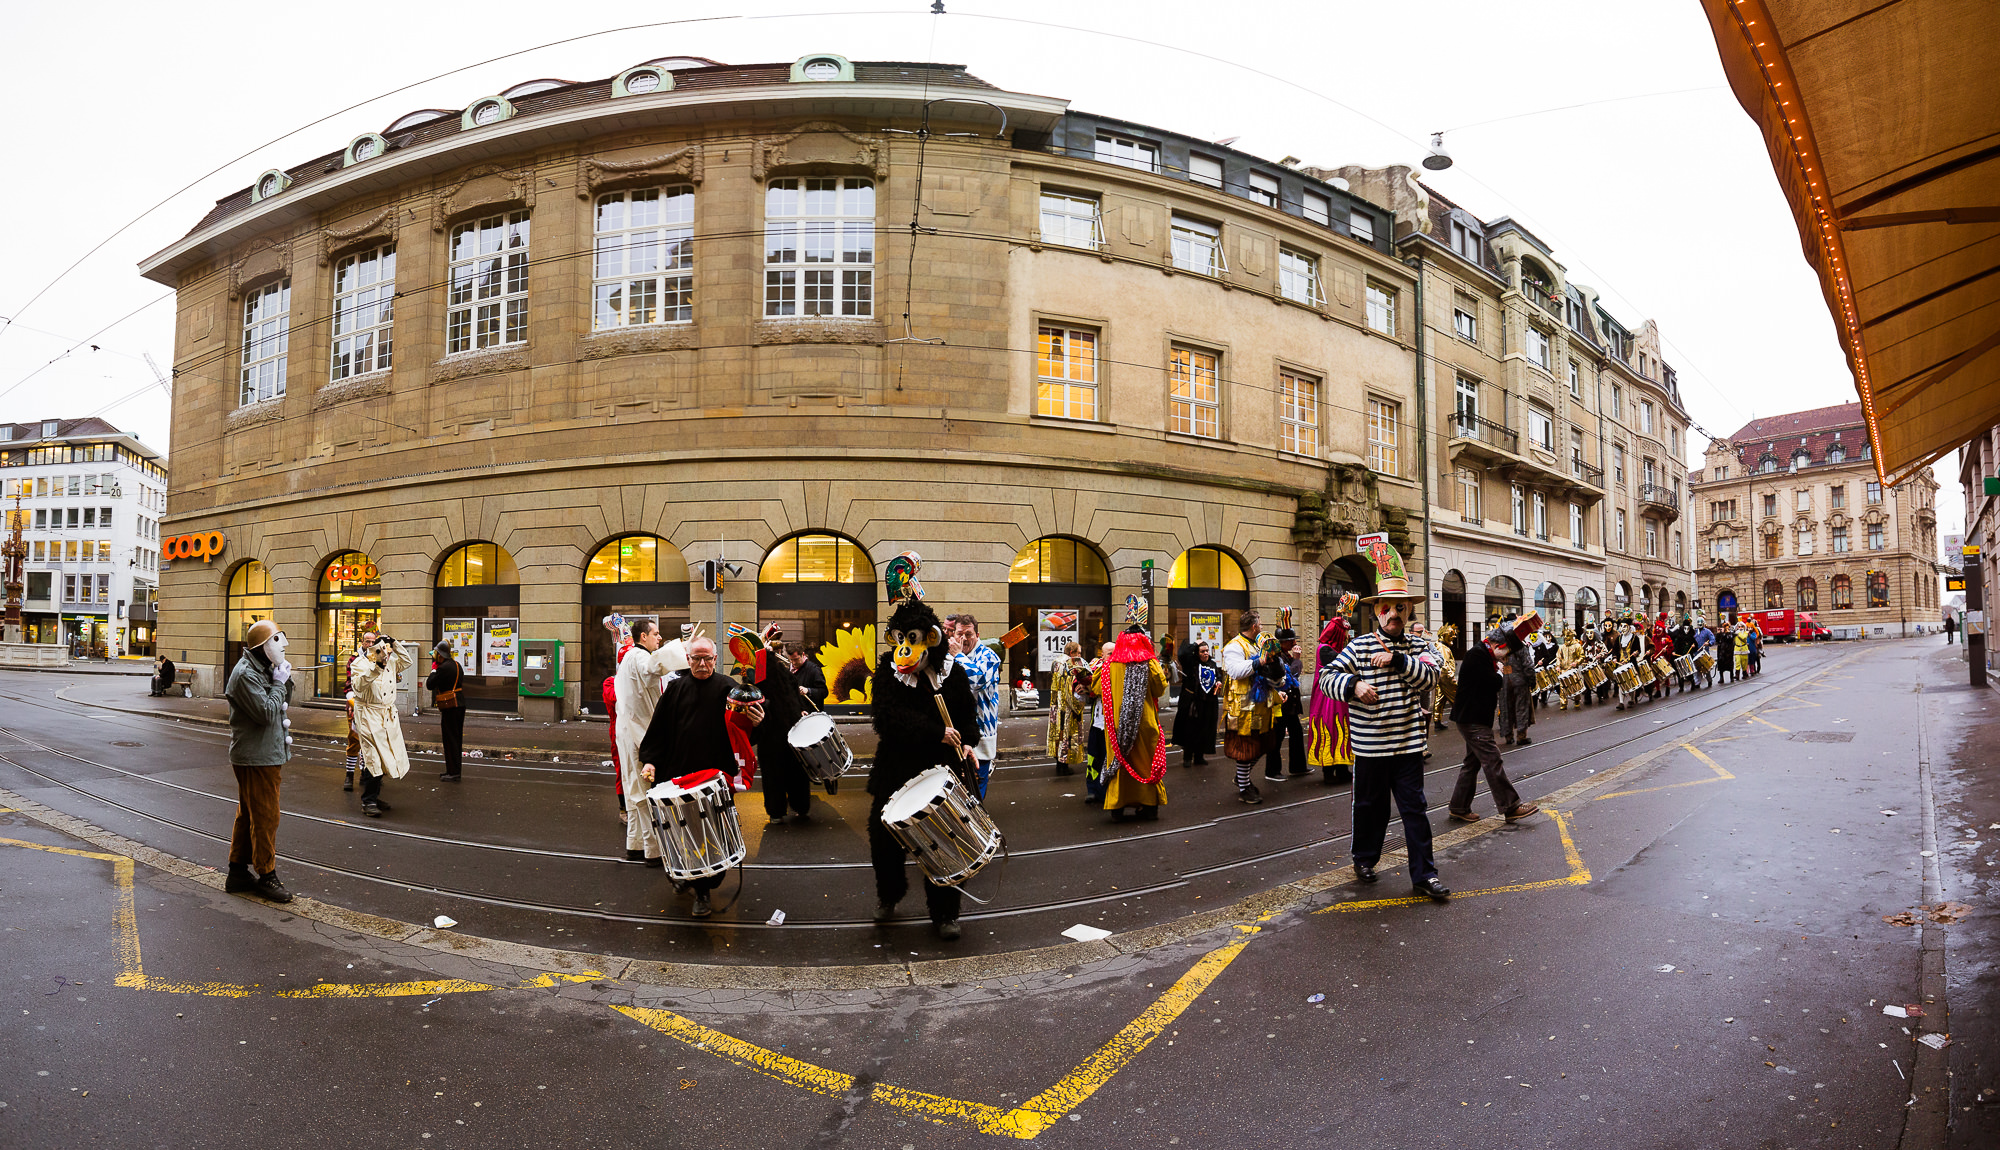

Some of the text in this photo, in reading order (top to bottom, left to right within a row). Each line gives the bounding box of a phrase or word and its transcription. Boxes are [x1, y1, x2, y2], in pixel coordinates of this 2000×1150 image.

[110, 487, 122, 497] 20
[163, 530, 224, 563] coop
[326, 563, 378, 584] coop
